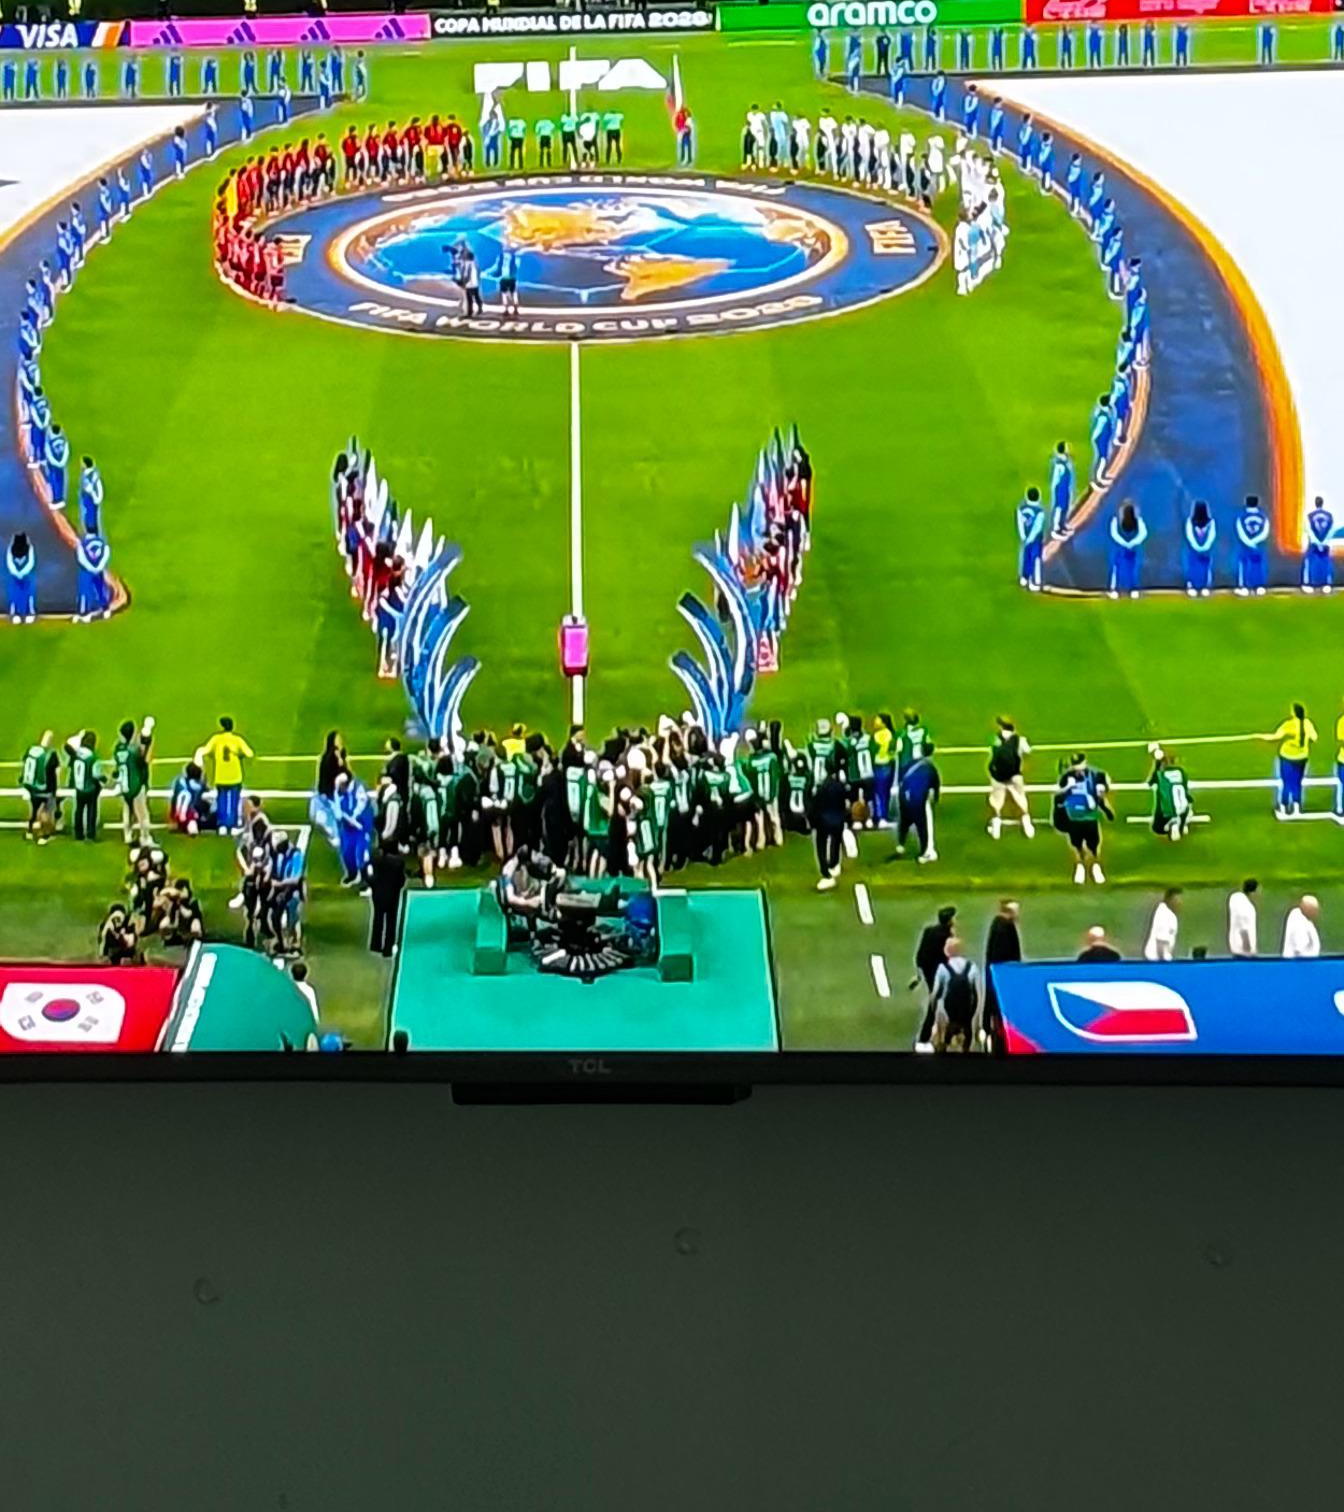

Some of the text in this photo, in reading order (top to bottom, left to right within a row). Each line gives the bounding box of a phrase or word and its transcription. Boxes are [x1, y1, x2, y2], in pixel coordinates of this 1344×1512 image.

[434, 17, 480, 33] COPA
[482, 15, 557, 33] MUNDIAL
[559, 14, 582, 30] DE
[584, 13, 606, 29] LA
[608, 12, 646, 29] FIFA
[807, 0, 937, 27] aramco
[14, 21, 79, 49] VISA
[474, 59, 668, 92] FIFA
[349, 301, 428, 325] FIFA
[436, 314, 585, 333] WORLD
[592, 318, 677, 332] CUP
[567, 1059, 612, 1075] TCL
